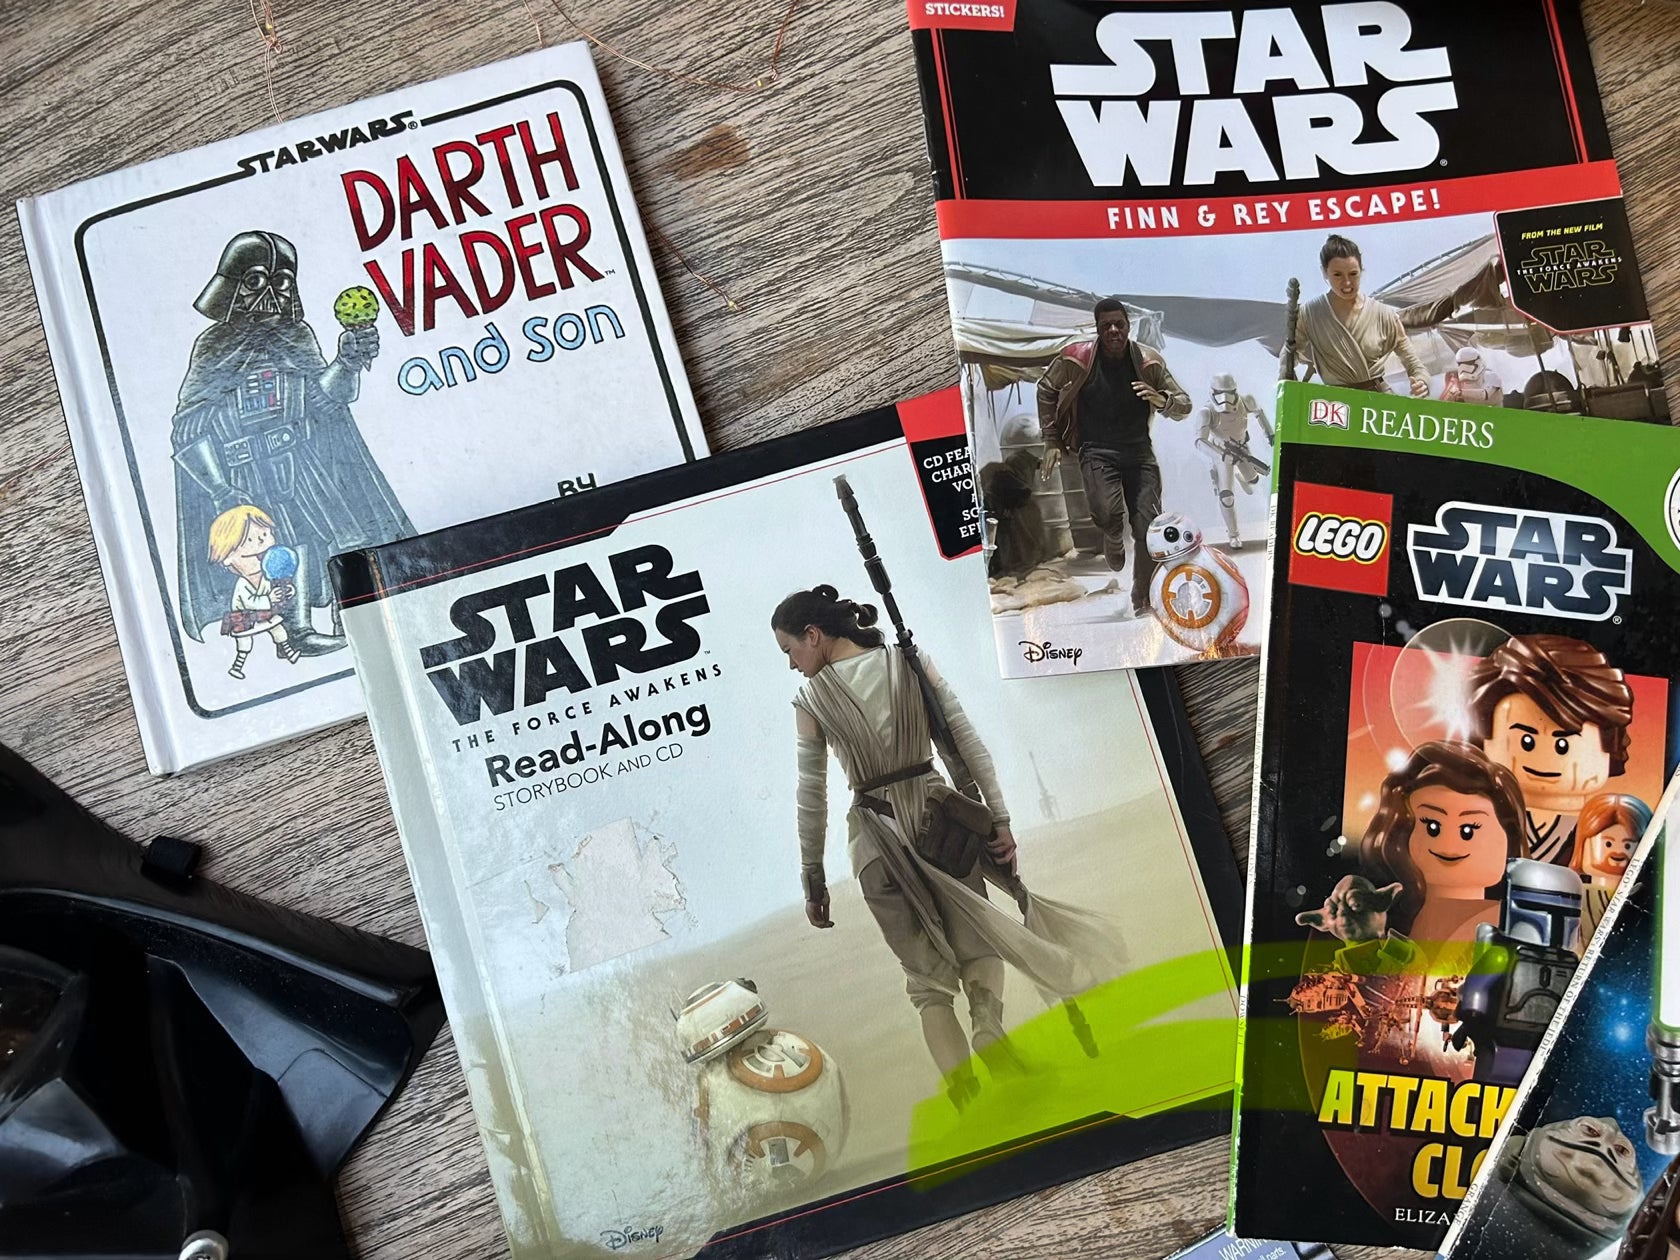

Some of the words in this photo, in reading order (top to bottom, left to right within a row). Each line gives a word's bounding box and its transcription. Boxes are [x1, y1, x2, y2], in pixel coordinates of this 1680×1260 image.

[925, 2, 1005, 18] STICKERS!
[1050, 0, 1451, 96] STAR
[341, 112, 579, 252] DARTH
[1108, 204, 1180, 231] FINN
[1197, 203, 1217, 228] &
[1234, 199, 1290, 226] REY
[1310, 190, 1442, 223] ESCAPE!
[1521, 230, 1544, 240] FROM
[1546, 227, 1562, 236] THE
[1564, 225, 1582, 235] NEW
[1584, 223, 1603, 232] FILM
[1517, 267, 1533, 275] THE
[1540, 263, 1571, 273] FORCE
[1577, 256, 1622, 268] AWAKENS
[1521, 240, 1615, 269] STAR
[1525, 264, 1618, 293] WARS
[397, 322, 511, 396] and
[522, 304, 625, 362] son
[1313, 401, 1345, 425] DK
[1360, 407, 1495, 448] READERS
[923, 455, 943, 469] CD
[1296, 514, 1385, 562] LEGO
[1411, 504, 1628, 571] STAR
[420, 544, 705, 670] STAR
[452, 730, 495, 752] THE
[512, 701, 593, 735] FORCE
[609, 664, 722, 708] AWAKENS
[484, 704, 711, 787] Read-Along
[494, 764, 613, 811] STORYBOOK
[617, 755, 651, 776] AND
[655, 743, 684, 763] CD
[1570, 949, 1596, 989] RETURN
[1395, 1208, 1457, 1226] ELIZA
[1454, 1183, 1479, 1226] GRANGE
